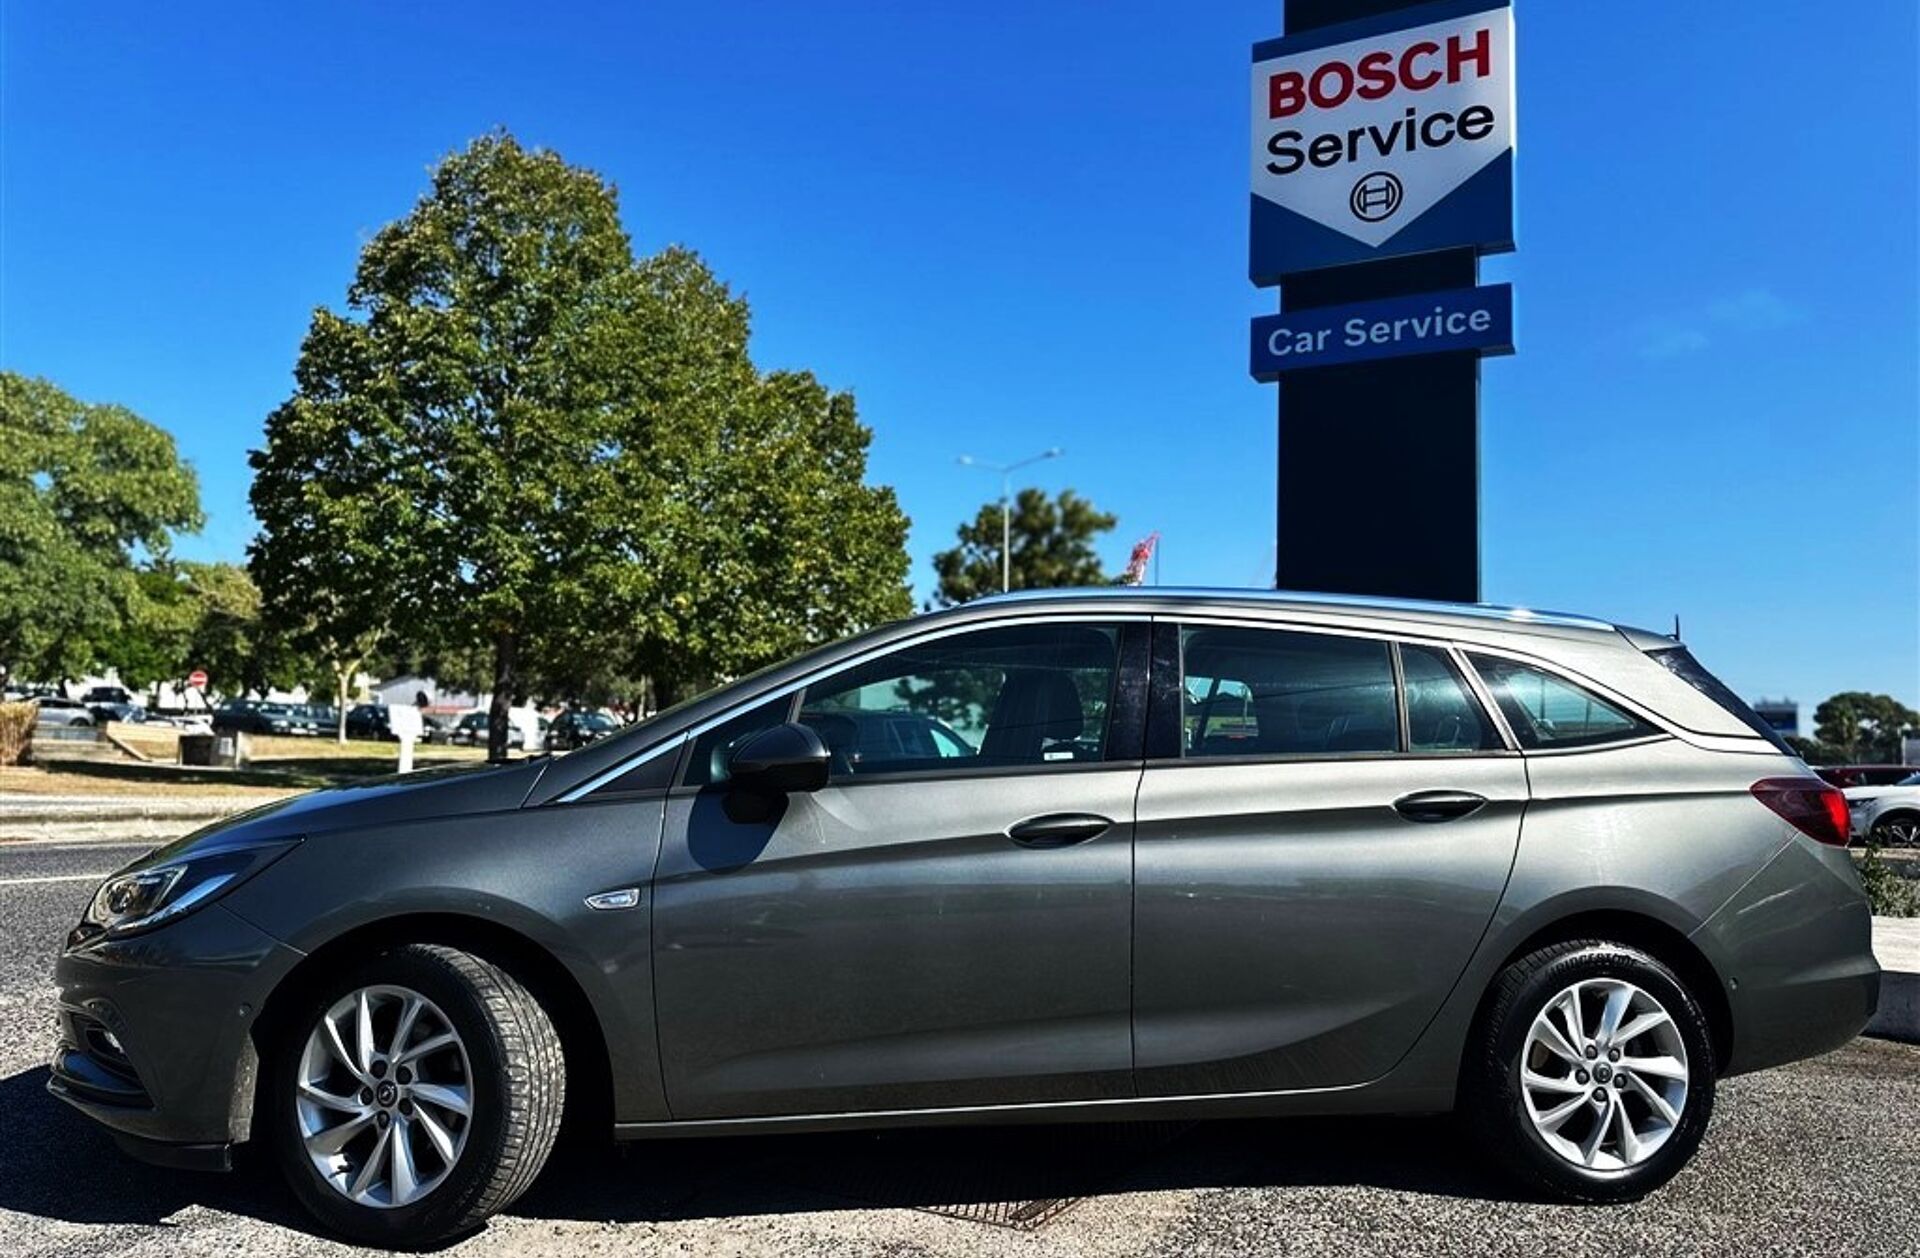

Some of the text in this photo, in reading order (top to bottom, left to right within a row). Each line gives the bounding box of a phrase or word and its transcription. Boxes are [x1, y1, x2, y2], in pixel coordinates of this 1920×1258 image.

[1269, 29, 1490, 119] BOSCH
[1266, 105, 1494, 175] Service
[1268, 306, 1491, 356] Car Service
